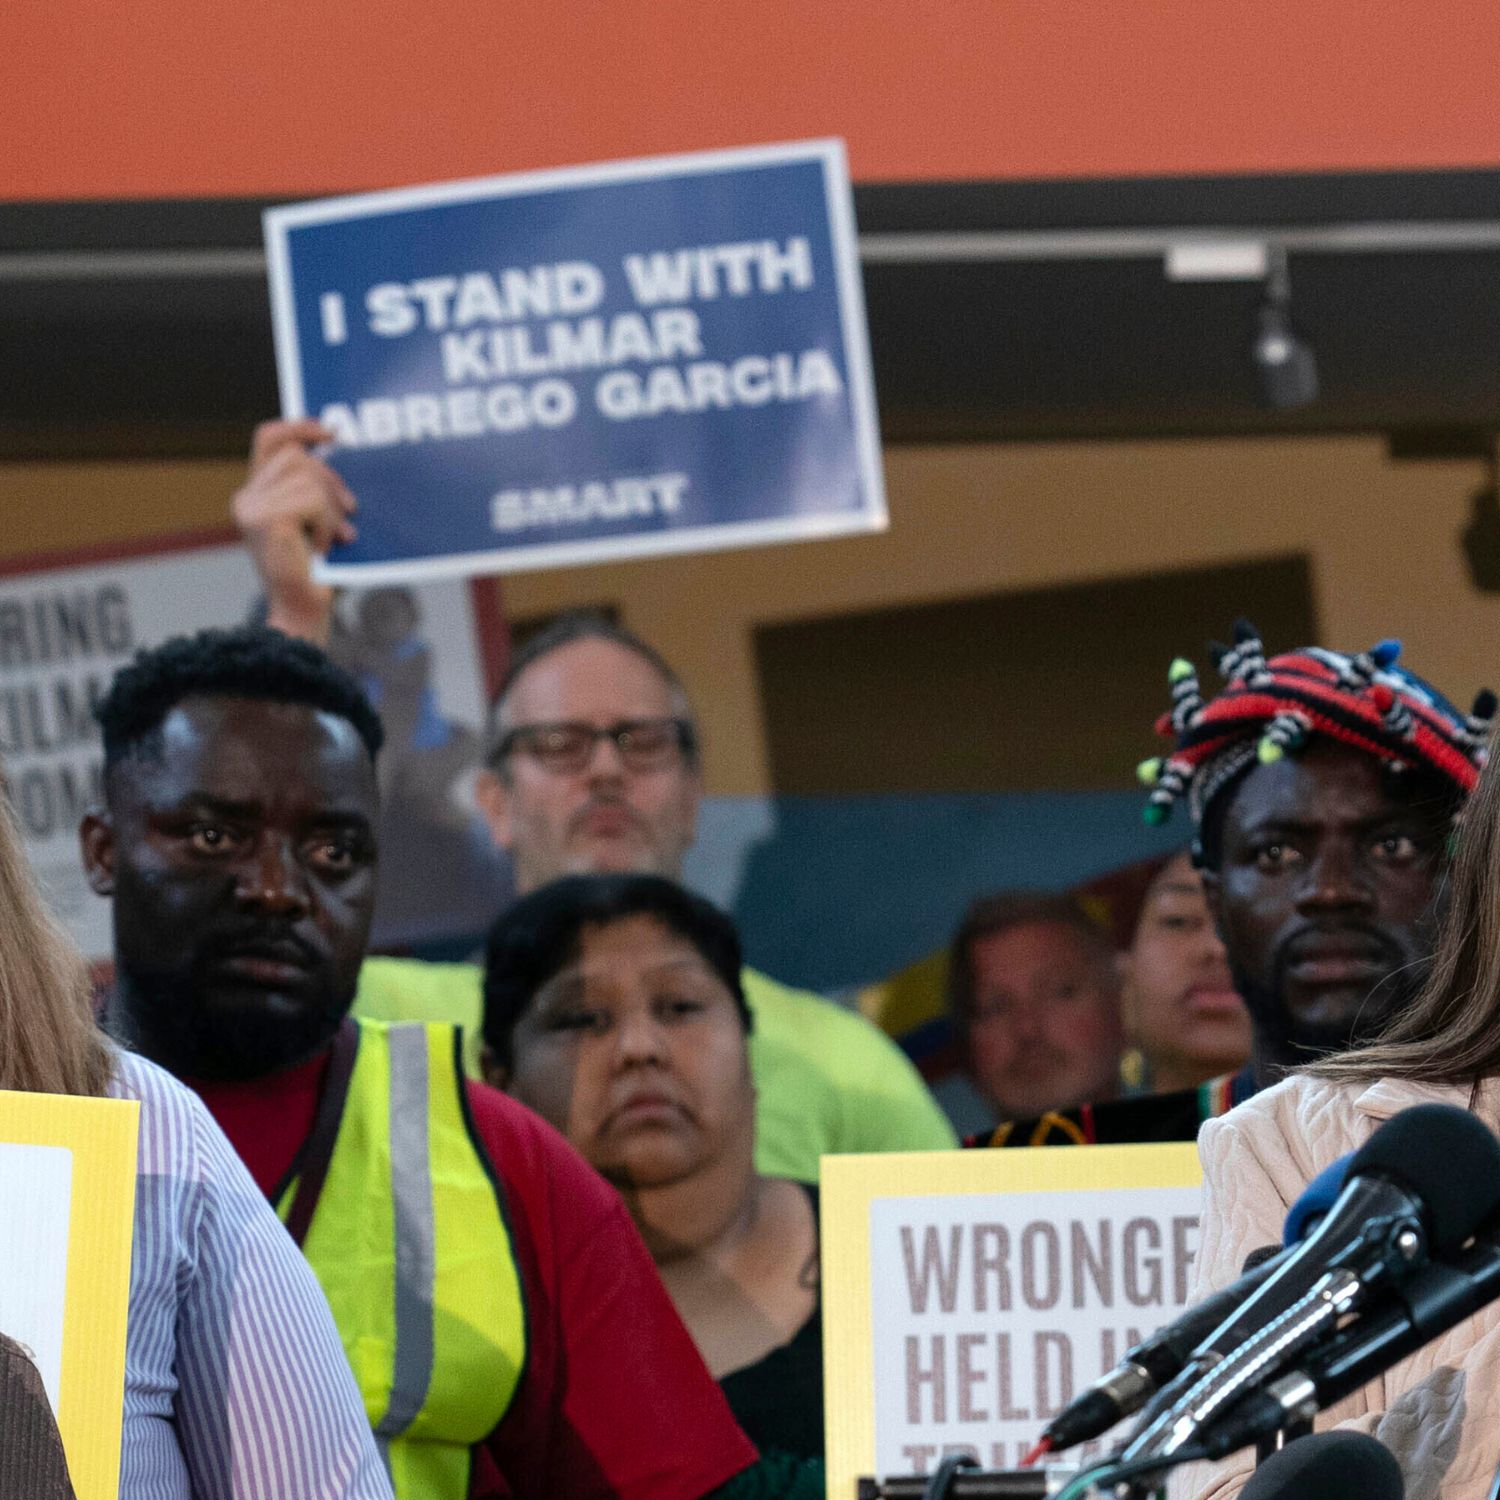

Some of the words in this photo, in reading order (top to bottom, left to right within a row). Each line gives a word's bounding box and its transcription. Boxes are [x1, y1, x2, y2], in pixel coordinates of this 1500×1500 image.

[320, 293, 346, 345] I
[367, 261, 604, 338] STAND
[623, 237, 813, 307] WITH
[441, 310, 703, 383] KILMAR
[320, 380, 576, 449] ABREGO
[598, 349, 843, 421] GARCIA
[490, 473, 688, 531] SMART
[899, 1216, 1200, 1316] WRONGF
[905, 1330, 1073, 1425] HELD
